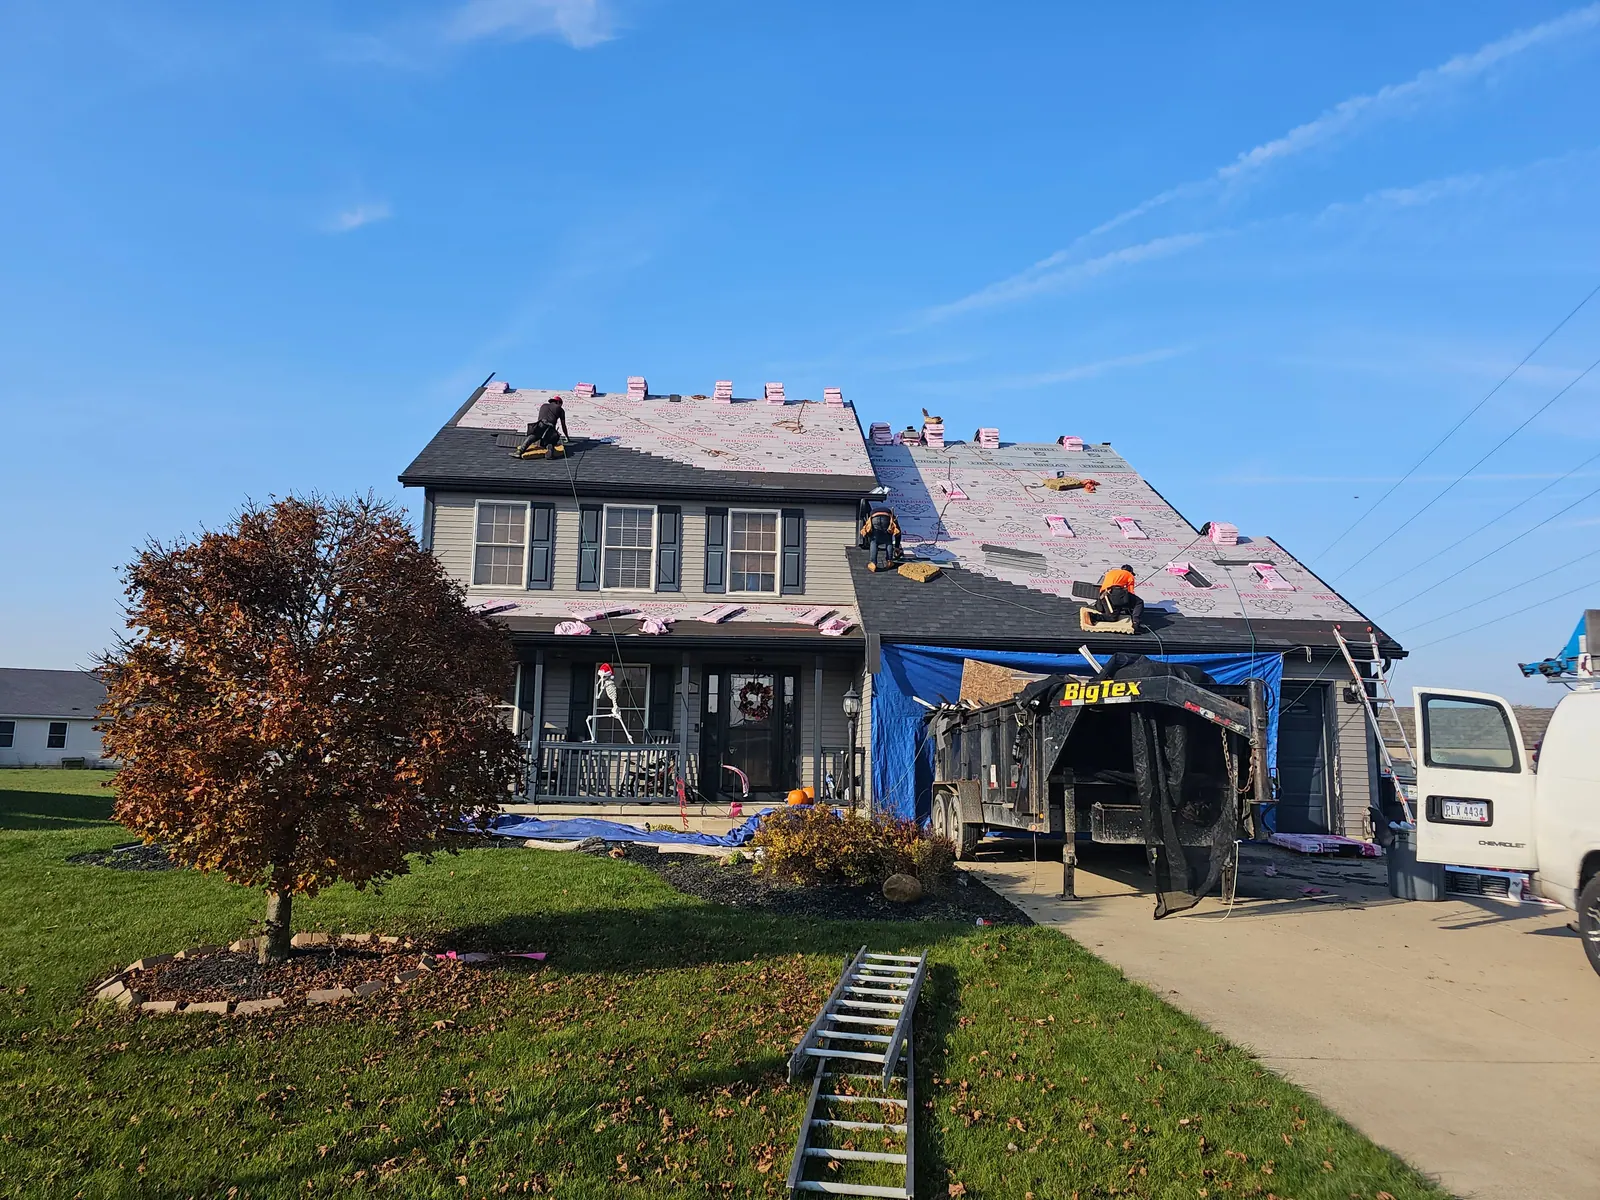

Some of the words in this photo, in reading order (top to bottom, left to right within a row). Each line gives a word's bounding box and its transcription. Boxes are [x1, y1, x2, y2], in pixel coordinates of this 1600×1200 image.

[788, 467, 833, 475] PROARMOR
[1445, 804, 1461, 816] PLX
[1464, 806, 1484, 817] 4434
[1478, 840, 1526, 848] CHEVROLET
